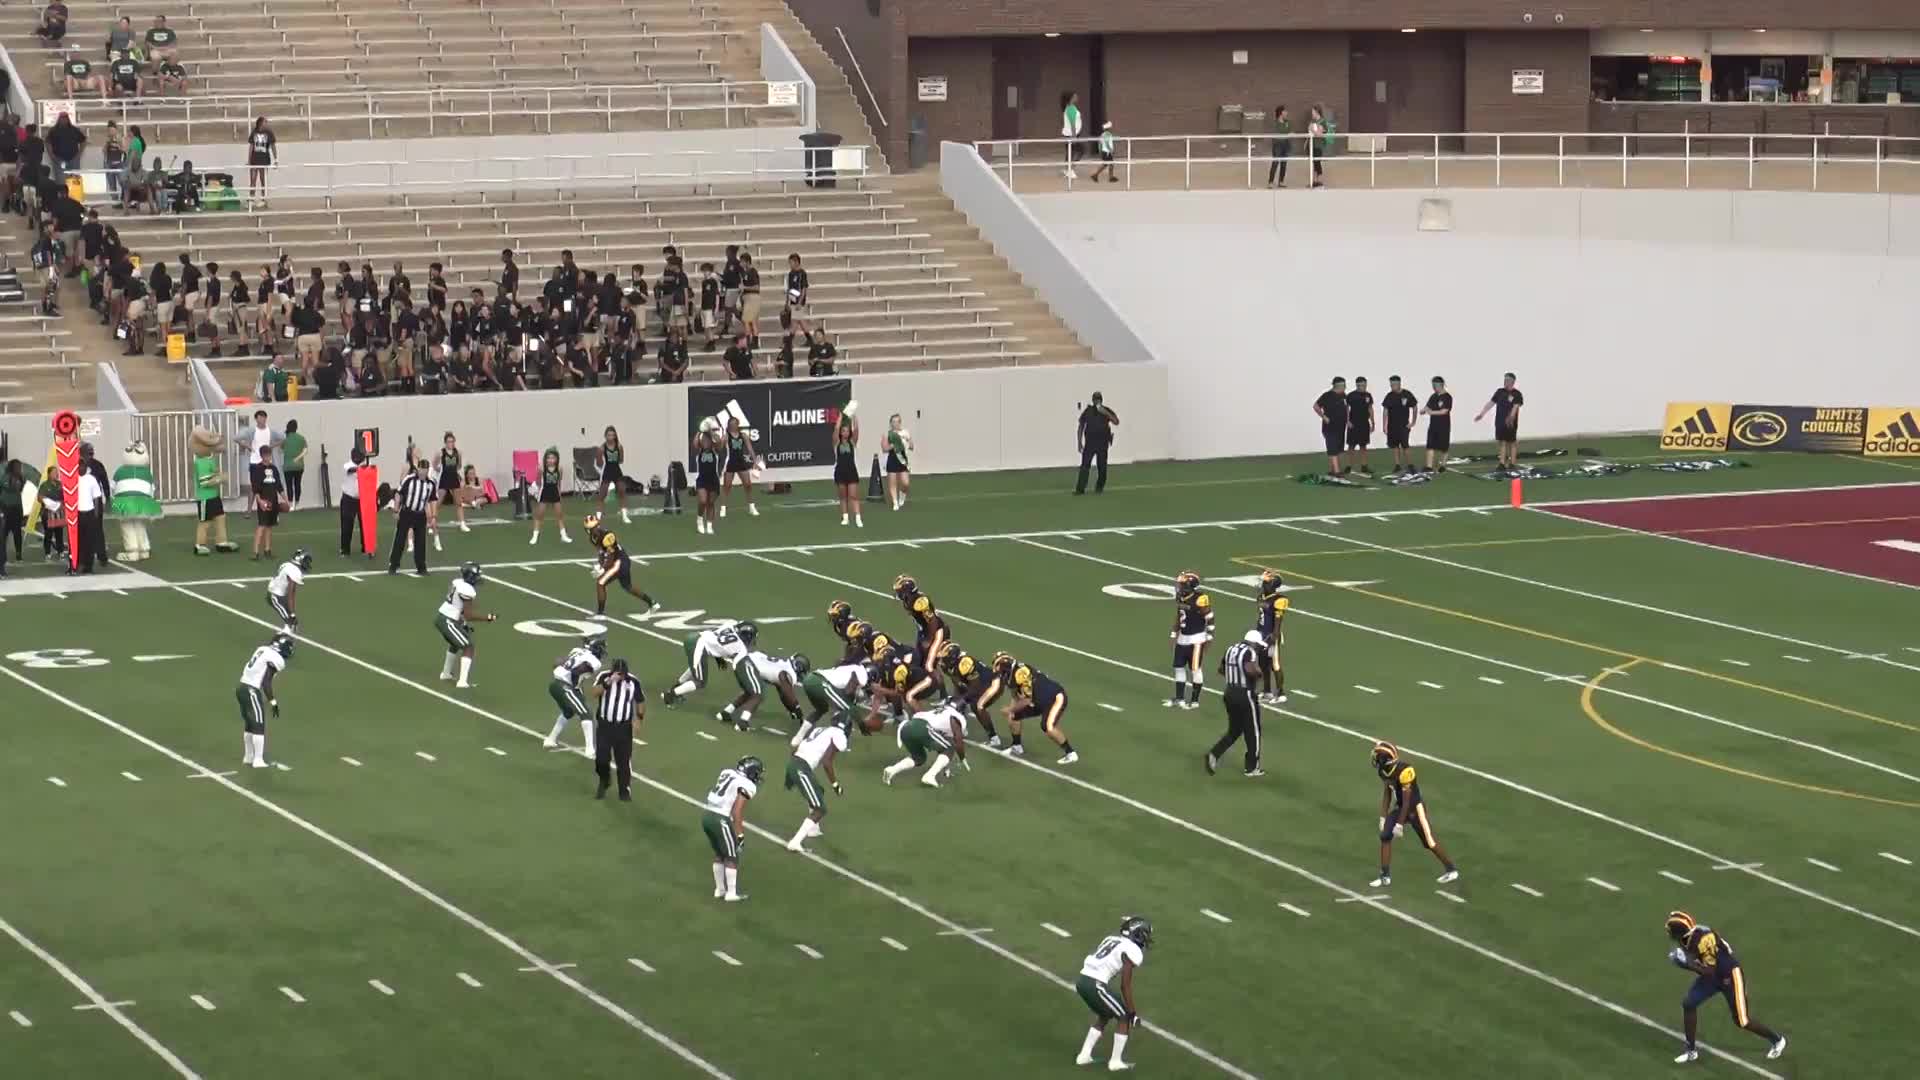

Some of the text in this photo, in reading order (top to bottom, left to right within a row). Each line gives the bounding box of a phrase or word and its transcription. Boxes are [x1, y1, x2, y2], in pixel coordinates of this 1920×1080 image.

[1816, 408, 1863, 421] NIMITZ
[1801, 420, 1861, 434] COUGARS
[362, 430, 373, 453] 1
[1662, 432, 1726, 448] adidas
